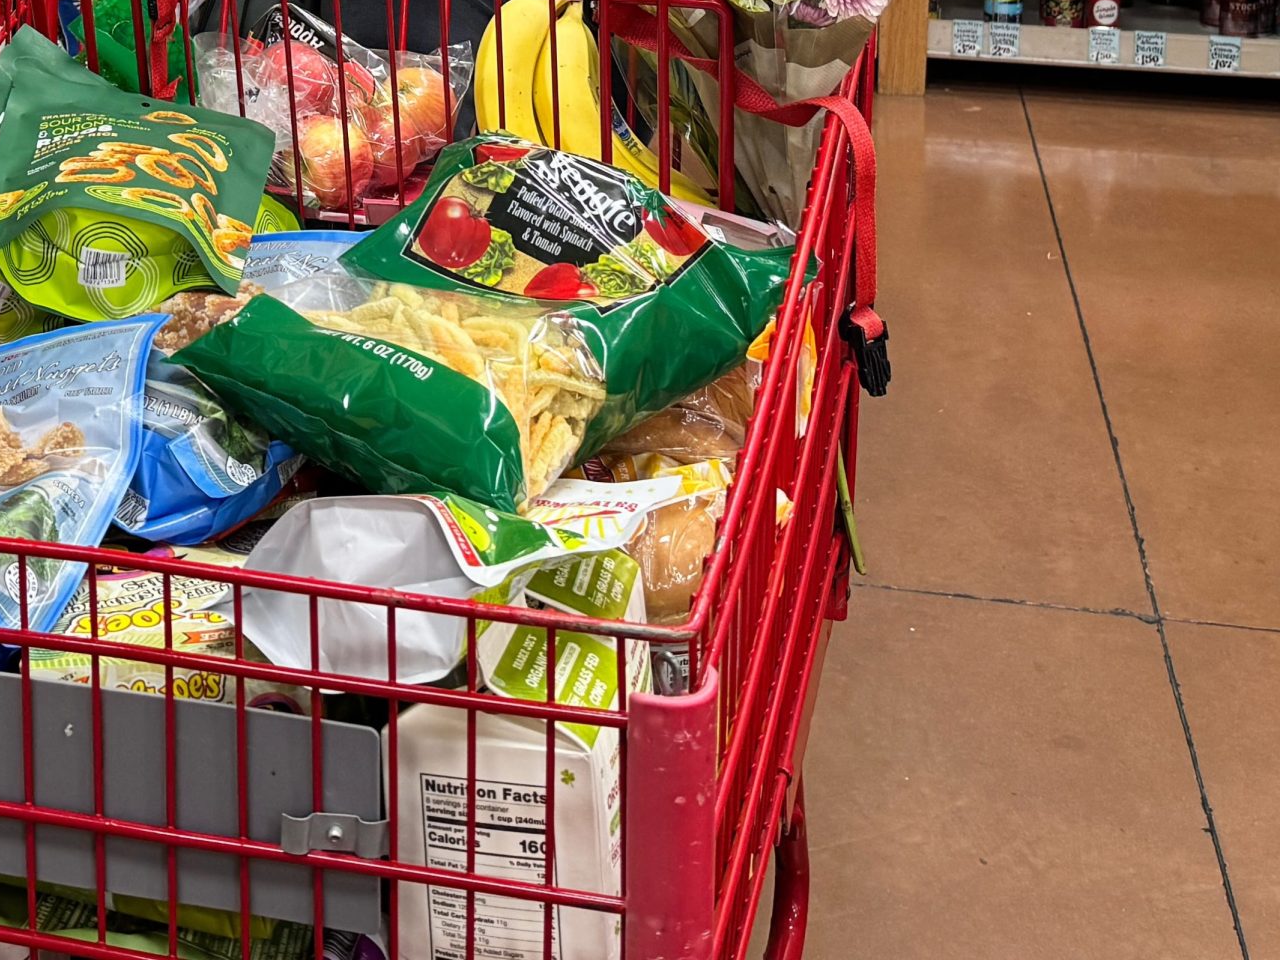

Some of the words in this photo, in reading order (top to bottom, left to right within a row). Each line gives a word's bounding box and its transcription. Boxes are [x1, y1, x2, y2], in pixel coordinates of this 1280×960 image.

[39, 116, 82, 129] SOUR
[52, 120, 104, 136] ONION
[517, 185, 542, 209] Puffed
[543, 199, 570, 222] Potato
[507, 200, 543, 228] Flavored
[543, 218, 562, 235] with
[560, 225, 593, 252] Spinach
[521, 228, 531, 240] &
[532, 232, 562, 256] Tomato
[27, 351, 121, 390] Nuggets
[362, 340, 376, 350] 6
[373, 344, 395, 358] OZ
[390, 352, 434, 380] (170g)
[575, 669, 592, 703] GRASS
[587, 653, 601, 669] FED
[425, 779, 497, 801] Nutrion
[503, 788, 547, 804] Facts
[476, 804, 509, 813] container
[498, 815, 512, 823] cup
[429, 831, 480, 848] Caloris
